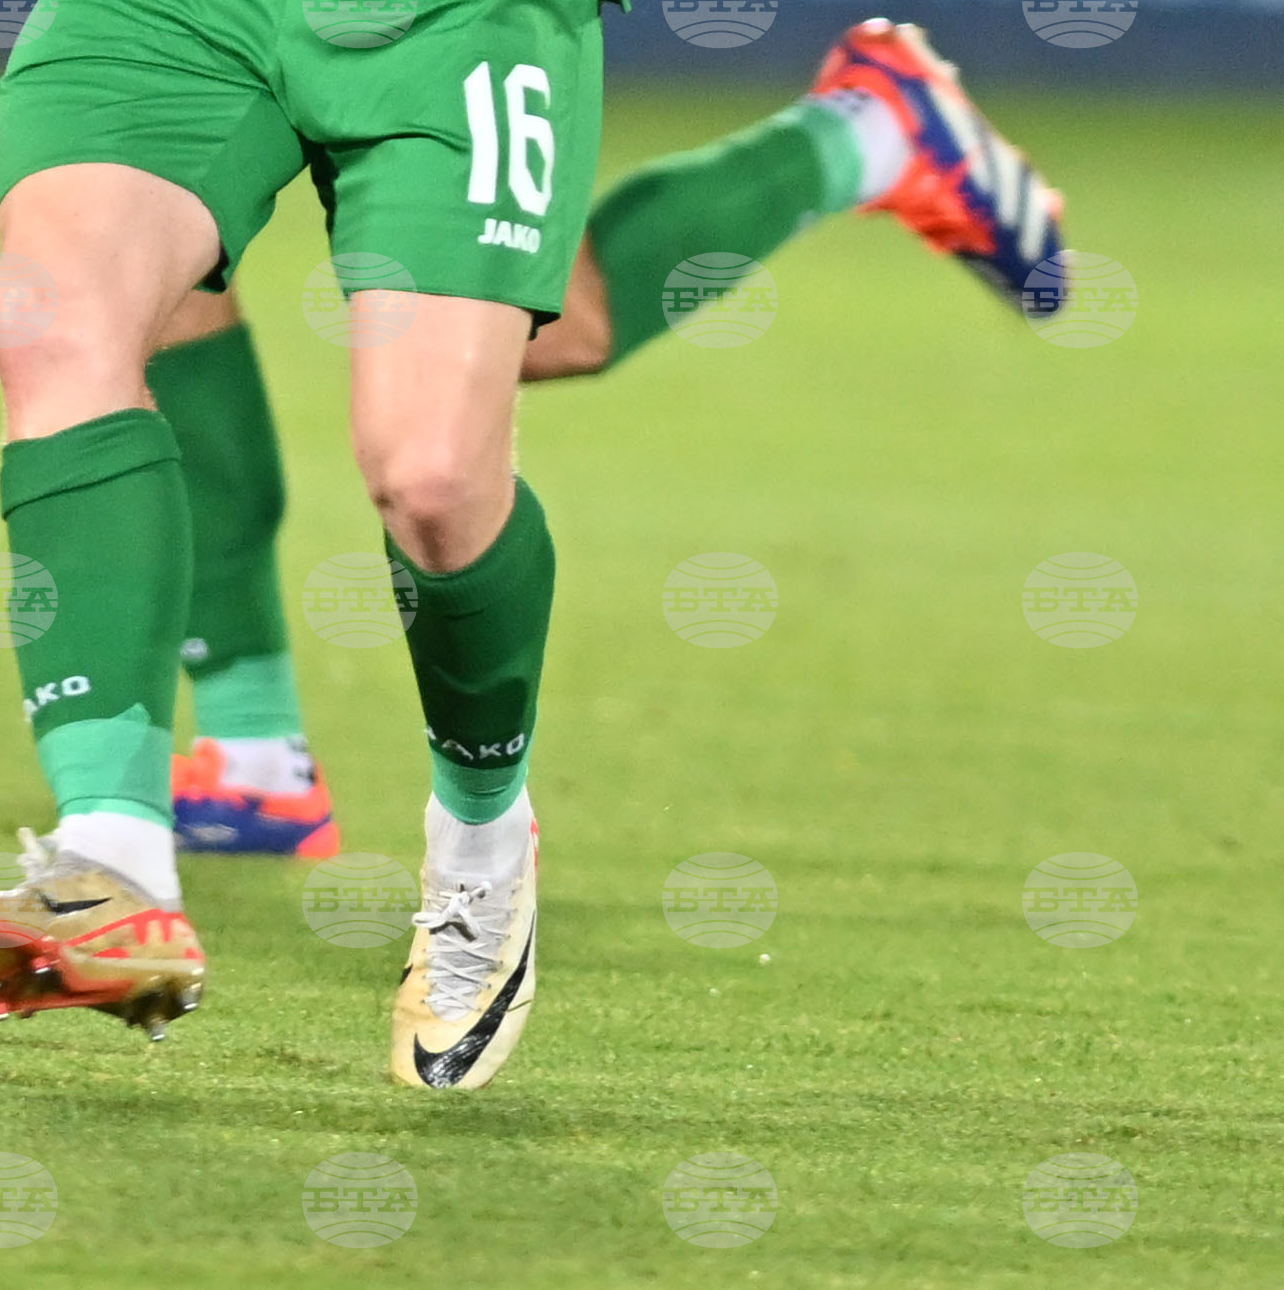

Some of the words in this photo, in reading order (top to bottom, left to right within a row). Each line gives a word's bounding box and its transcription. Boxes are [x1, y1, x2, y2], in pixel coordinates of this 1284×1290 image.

[463, 61, 555, 216] 16
[478, 218, 541, 254] JAKO
[23, 675, 91, 723] AKO
